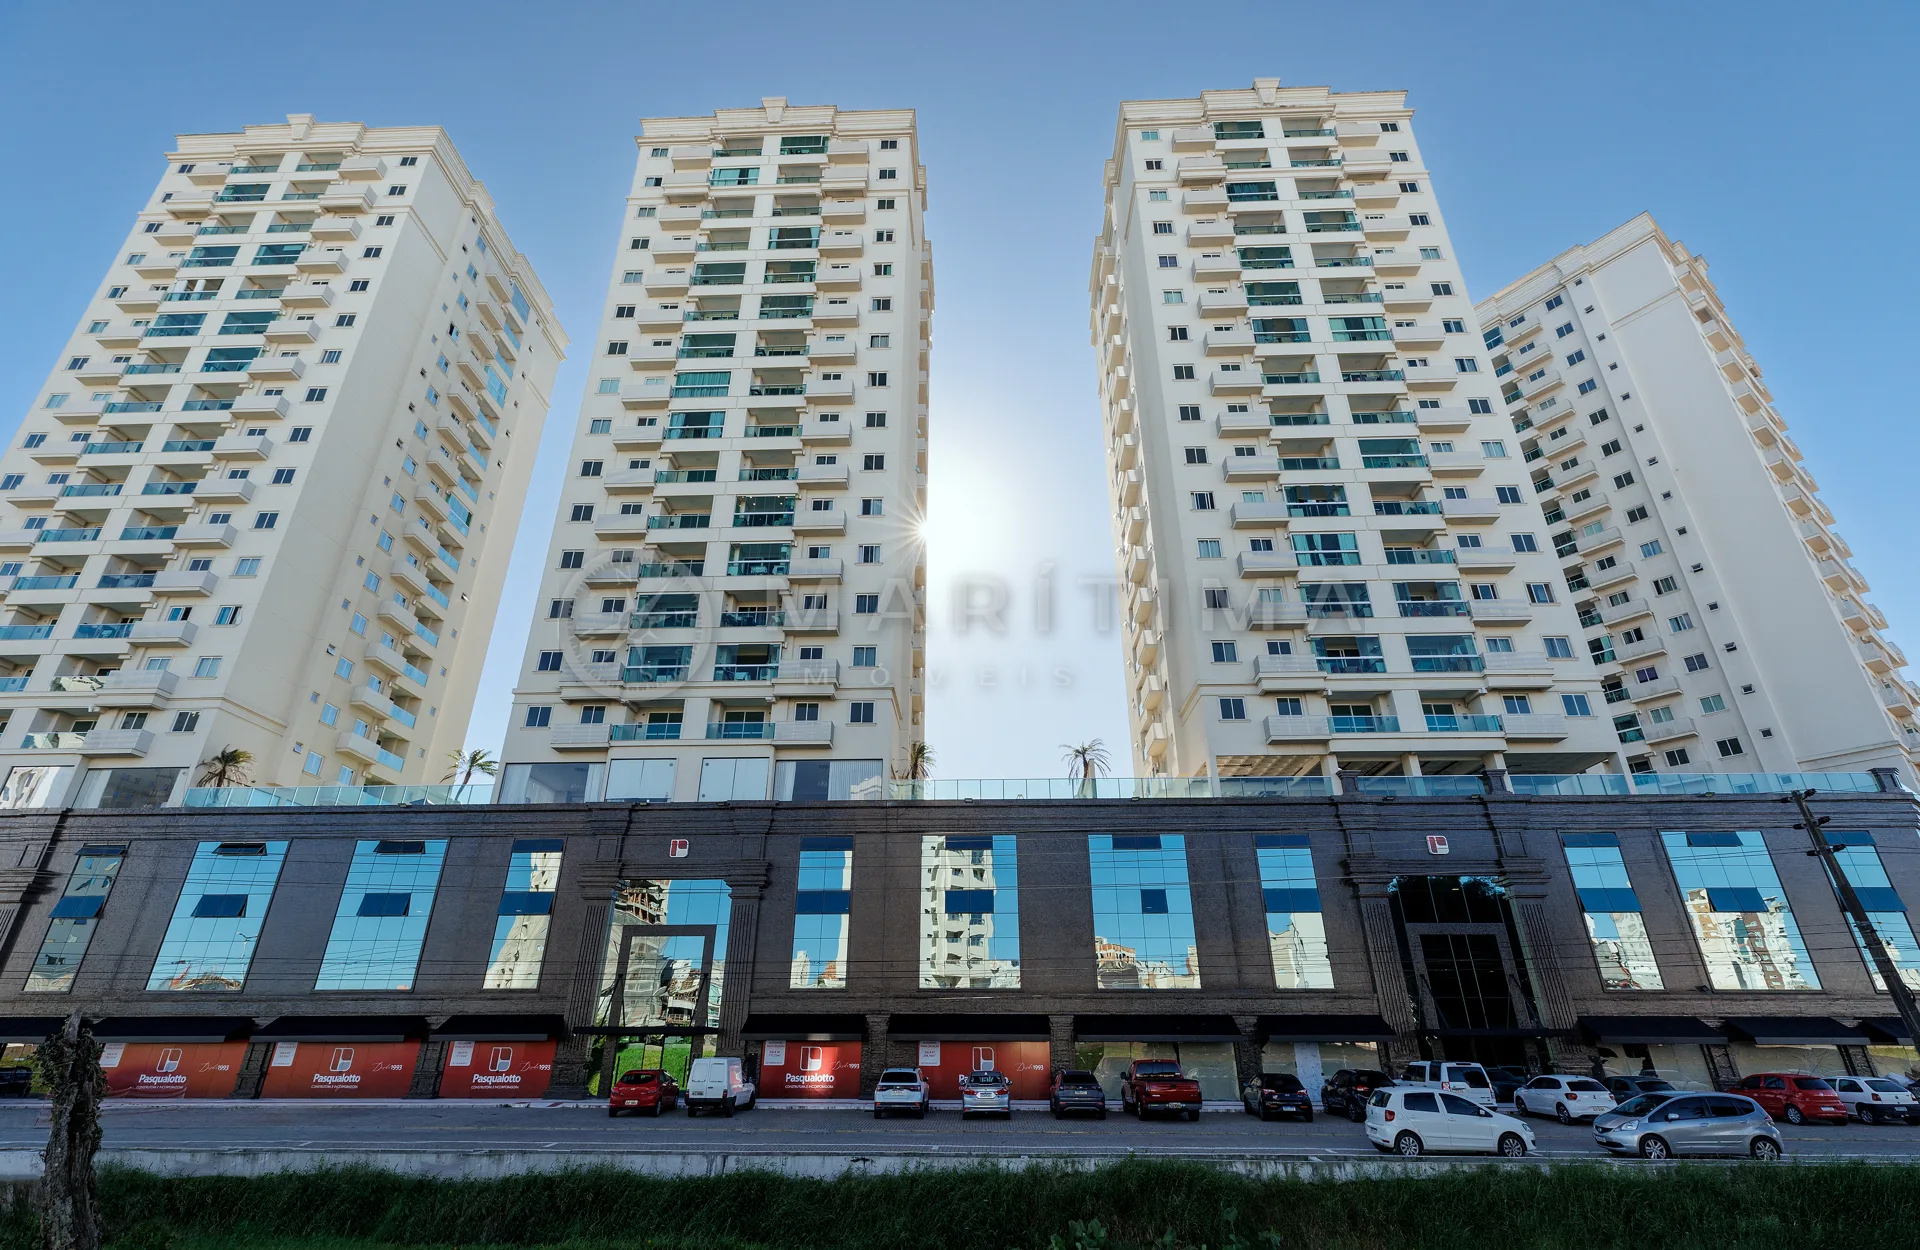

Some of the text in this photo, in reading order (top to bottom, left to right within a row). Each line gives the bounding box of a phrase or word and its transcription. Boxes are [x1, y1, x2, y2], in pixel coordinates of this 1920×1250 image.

[139, 1073, 187, 1085] Pasqualotto
[313, 1073, 361, 1084] Pasqualotto
[472, 1073, 521, 1085] Pasqualotto
[785, 1073, 835, 1084] Pasqualotto
